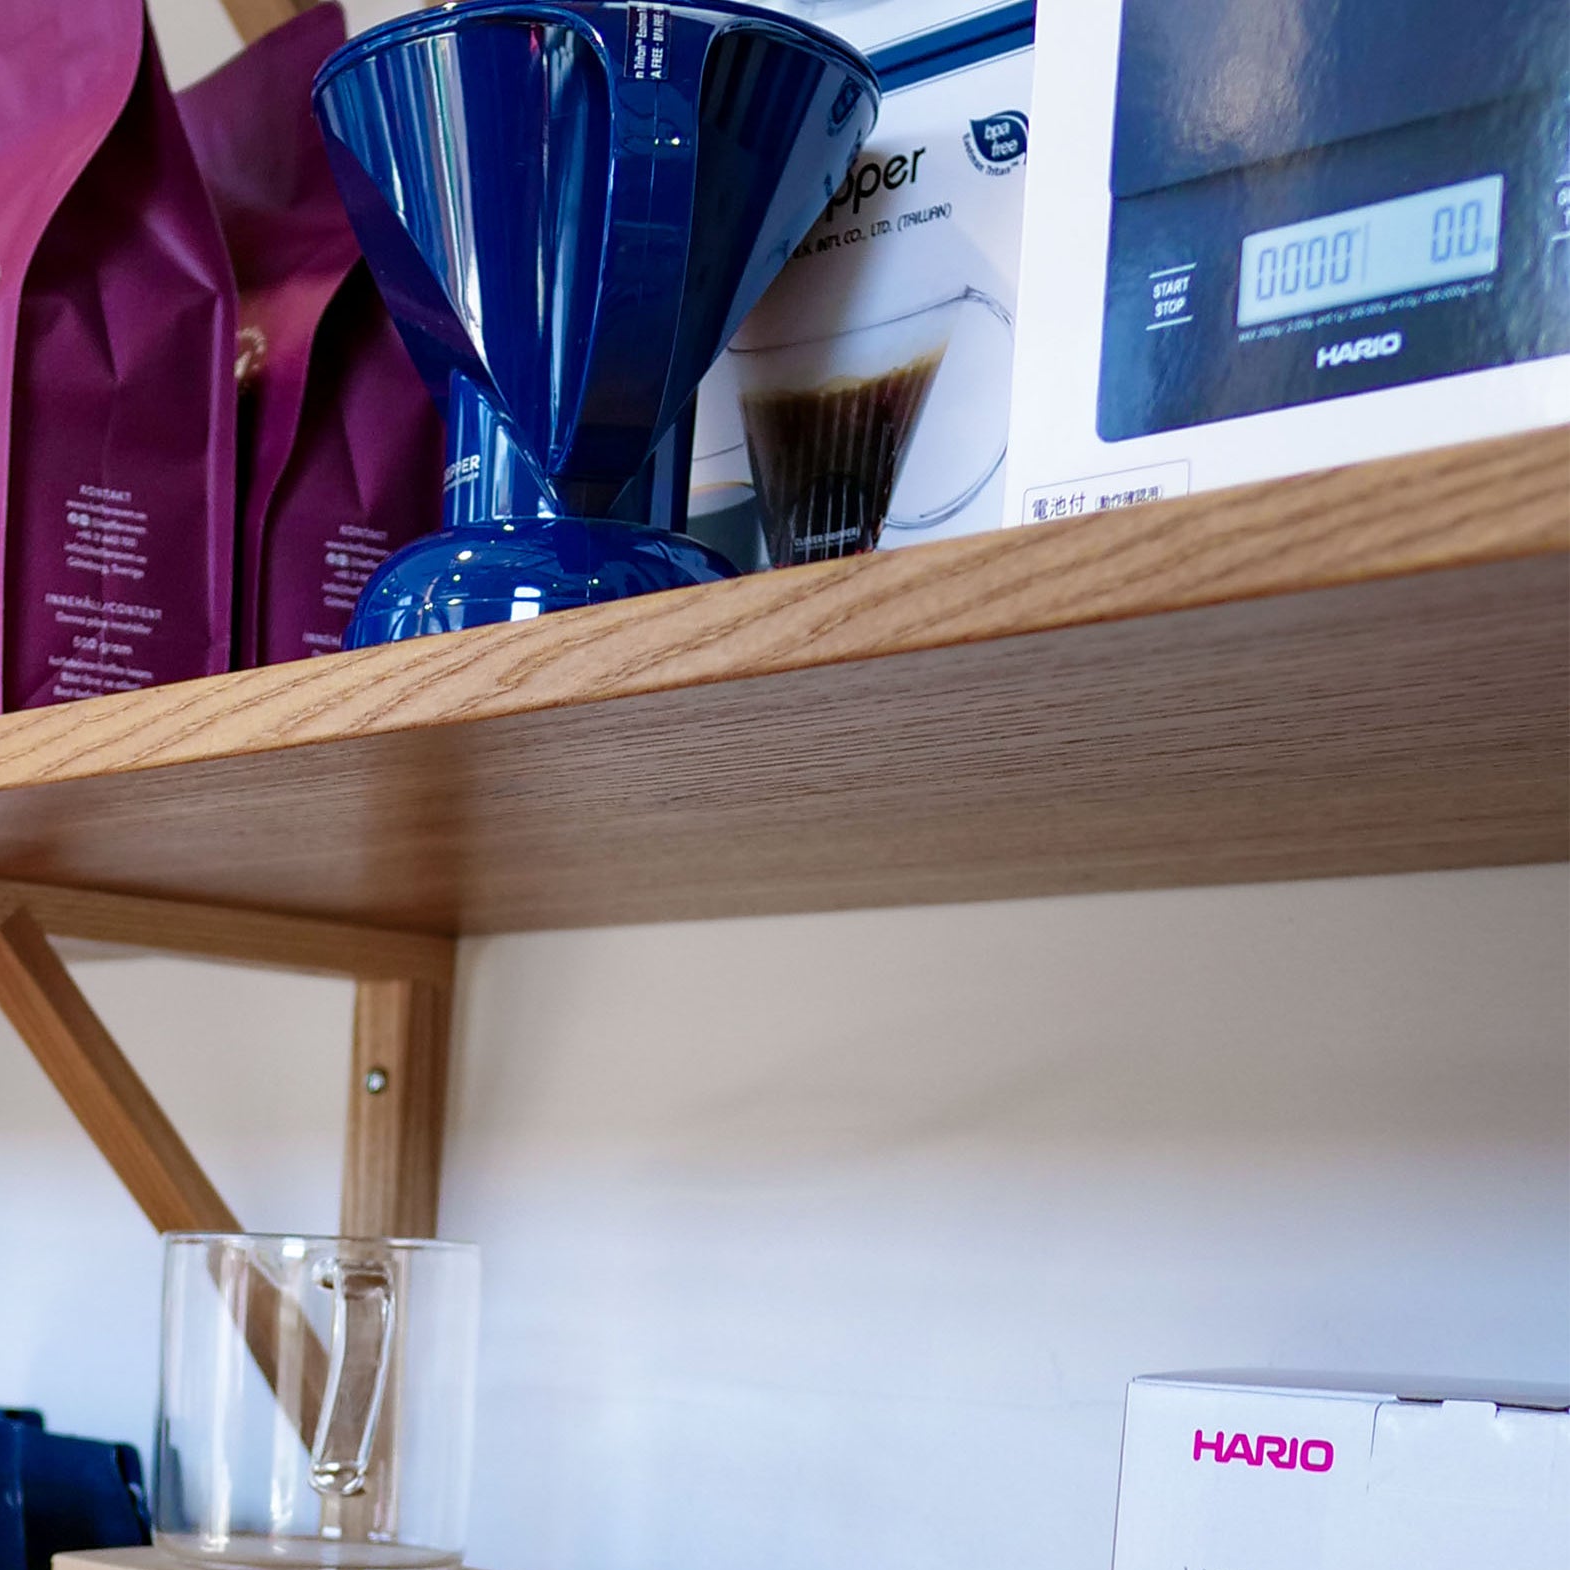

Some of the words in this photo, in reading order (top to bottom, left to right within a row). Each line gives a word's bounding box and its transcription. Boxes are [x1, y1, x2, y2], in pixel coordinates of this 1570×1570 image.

[990, 138, 1020, 159] free
[1152, 275, 1191, 300] START
[1154, 296, 1187, 318] STOP
[1316, 332, 1403, 369] HARIO
[1032, 491, 1086, 520] 電池付
[1193, 1429, 1335, 1473] HARIO
